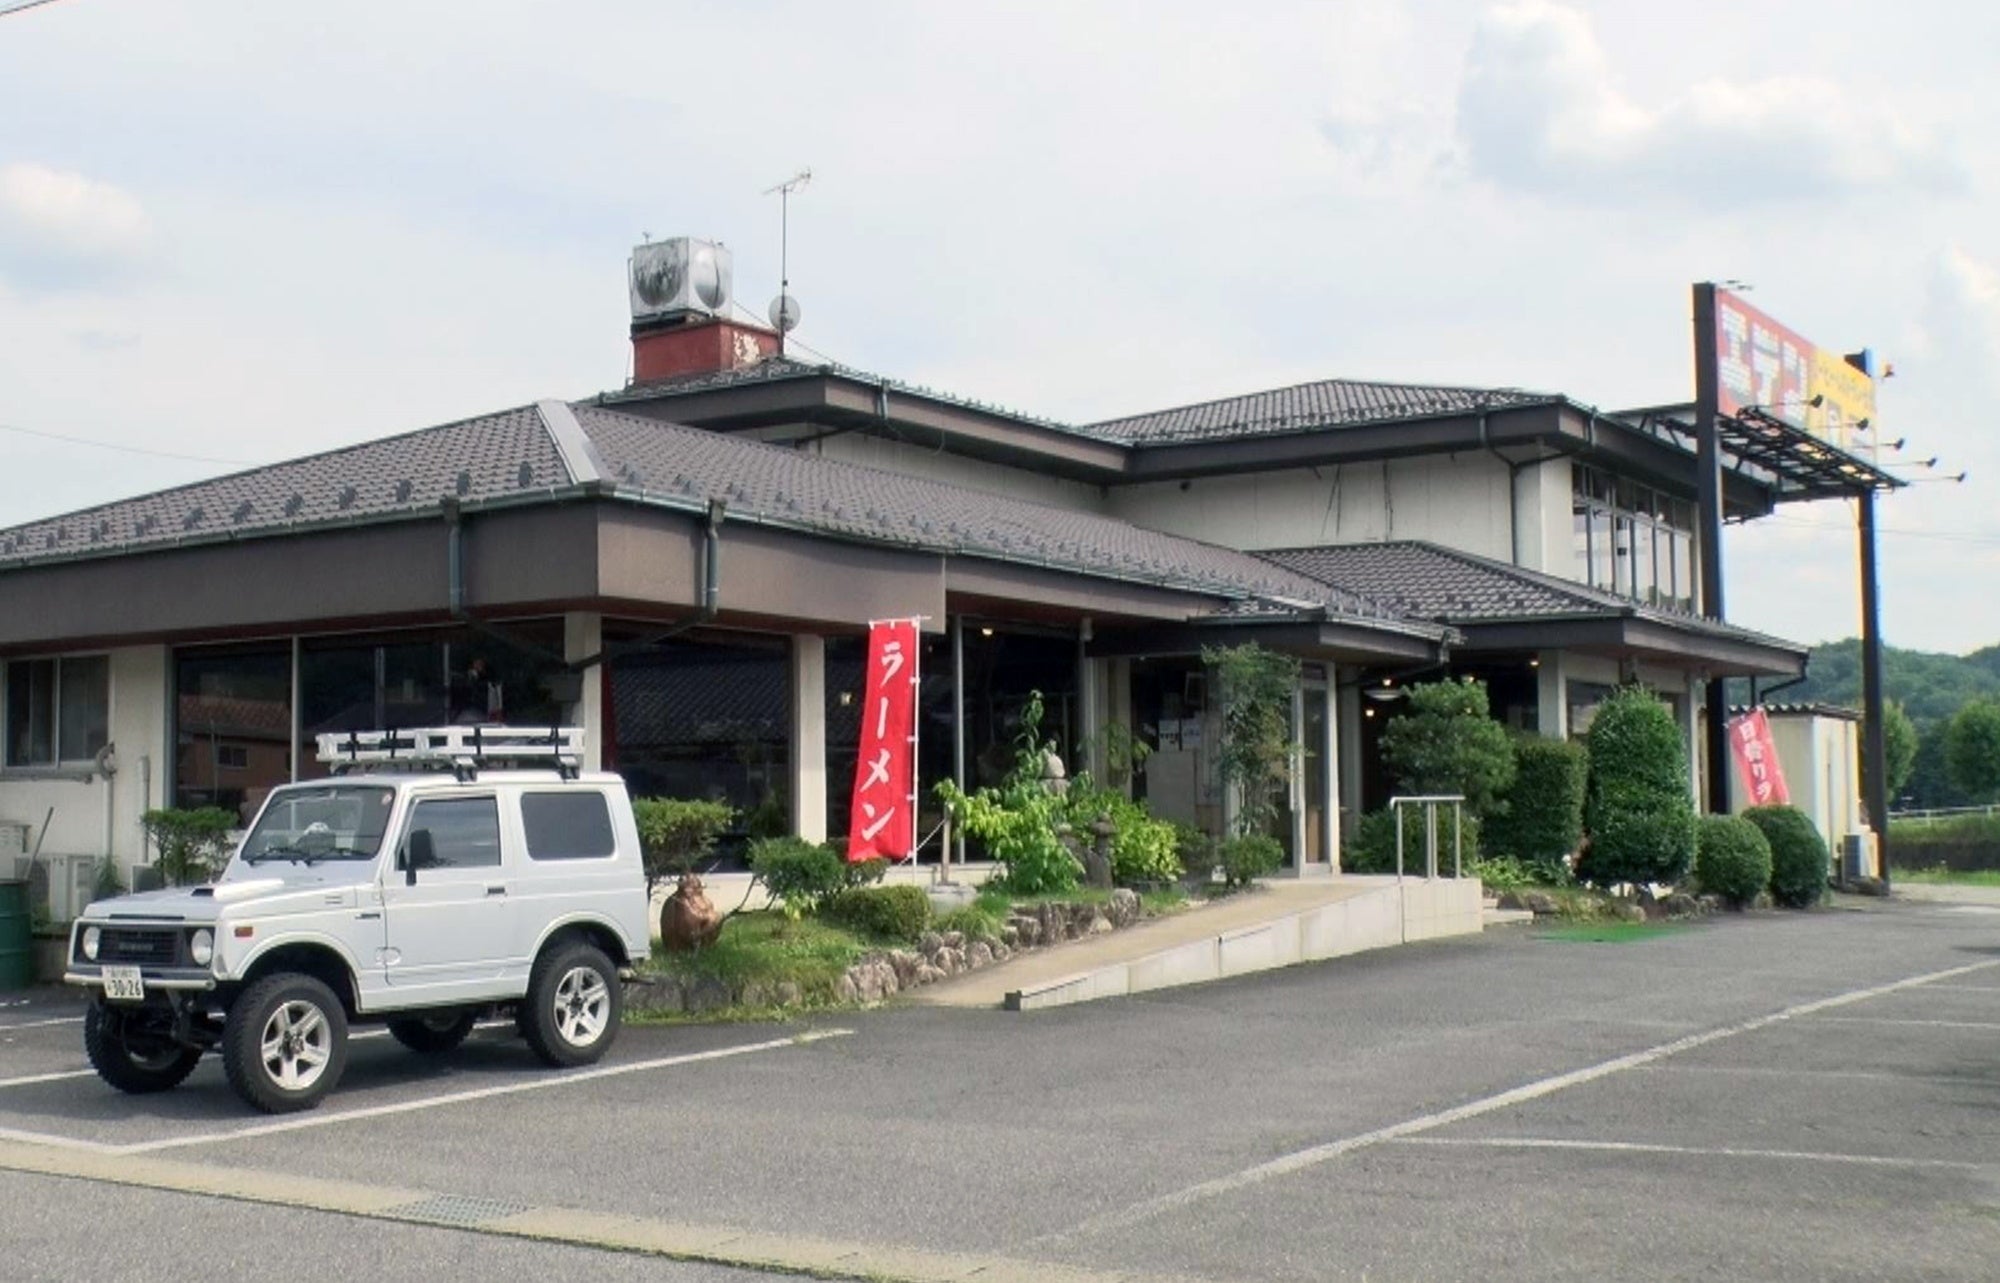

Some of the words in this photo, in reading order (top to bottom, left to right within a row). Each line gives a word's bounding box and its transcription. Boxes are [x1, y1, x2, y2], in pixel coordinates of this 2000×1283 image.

[1719, 304, 1808, 426] エデン
[859, 641, 904, 841] ラーメン
